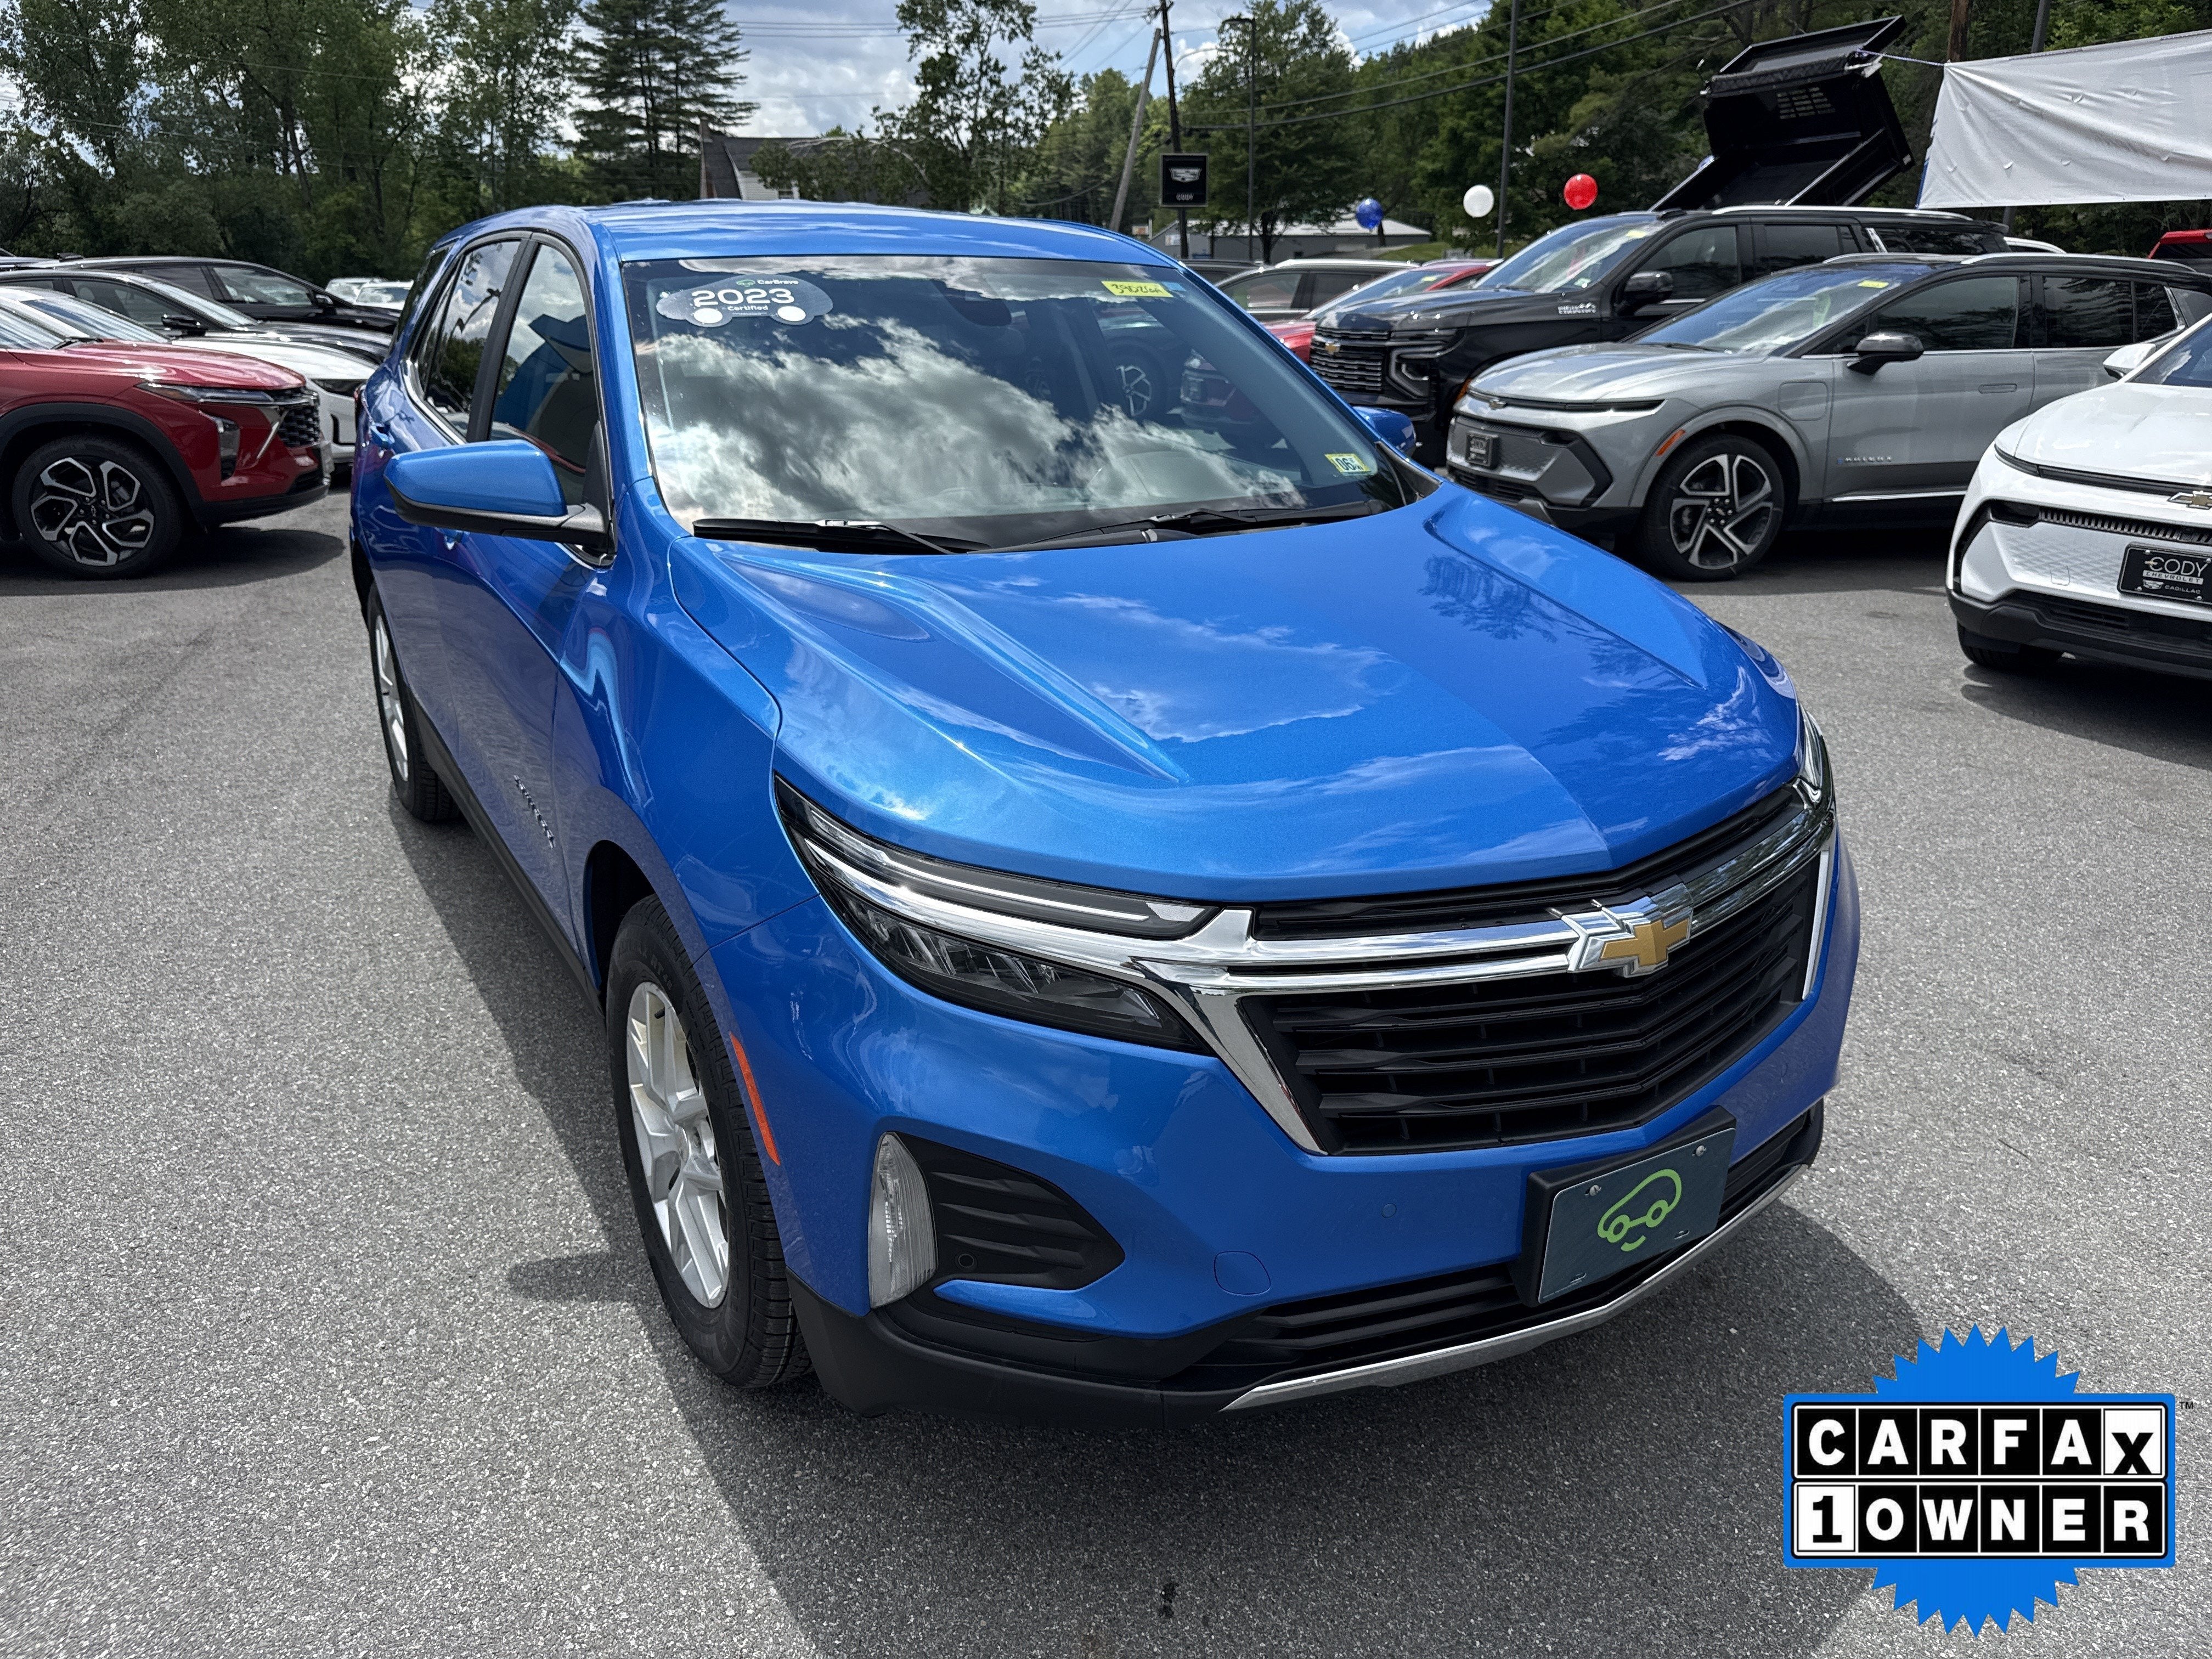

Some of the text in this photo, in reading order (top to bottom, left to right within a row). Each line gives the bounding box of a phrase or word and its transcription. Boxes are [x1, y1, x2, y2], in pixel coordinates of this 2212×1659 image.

[691, 288, 795, 307] 2023
[1335, 458, 1357, 471] 06
[2149, 556, 2208, 577] CODY
[2146, 572, 2201, 583] CHEVROLET
[2164, 585, 2201, 594] CADILLAC
